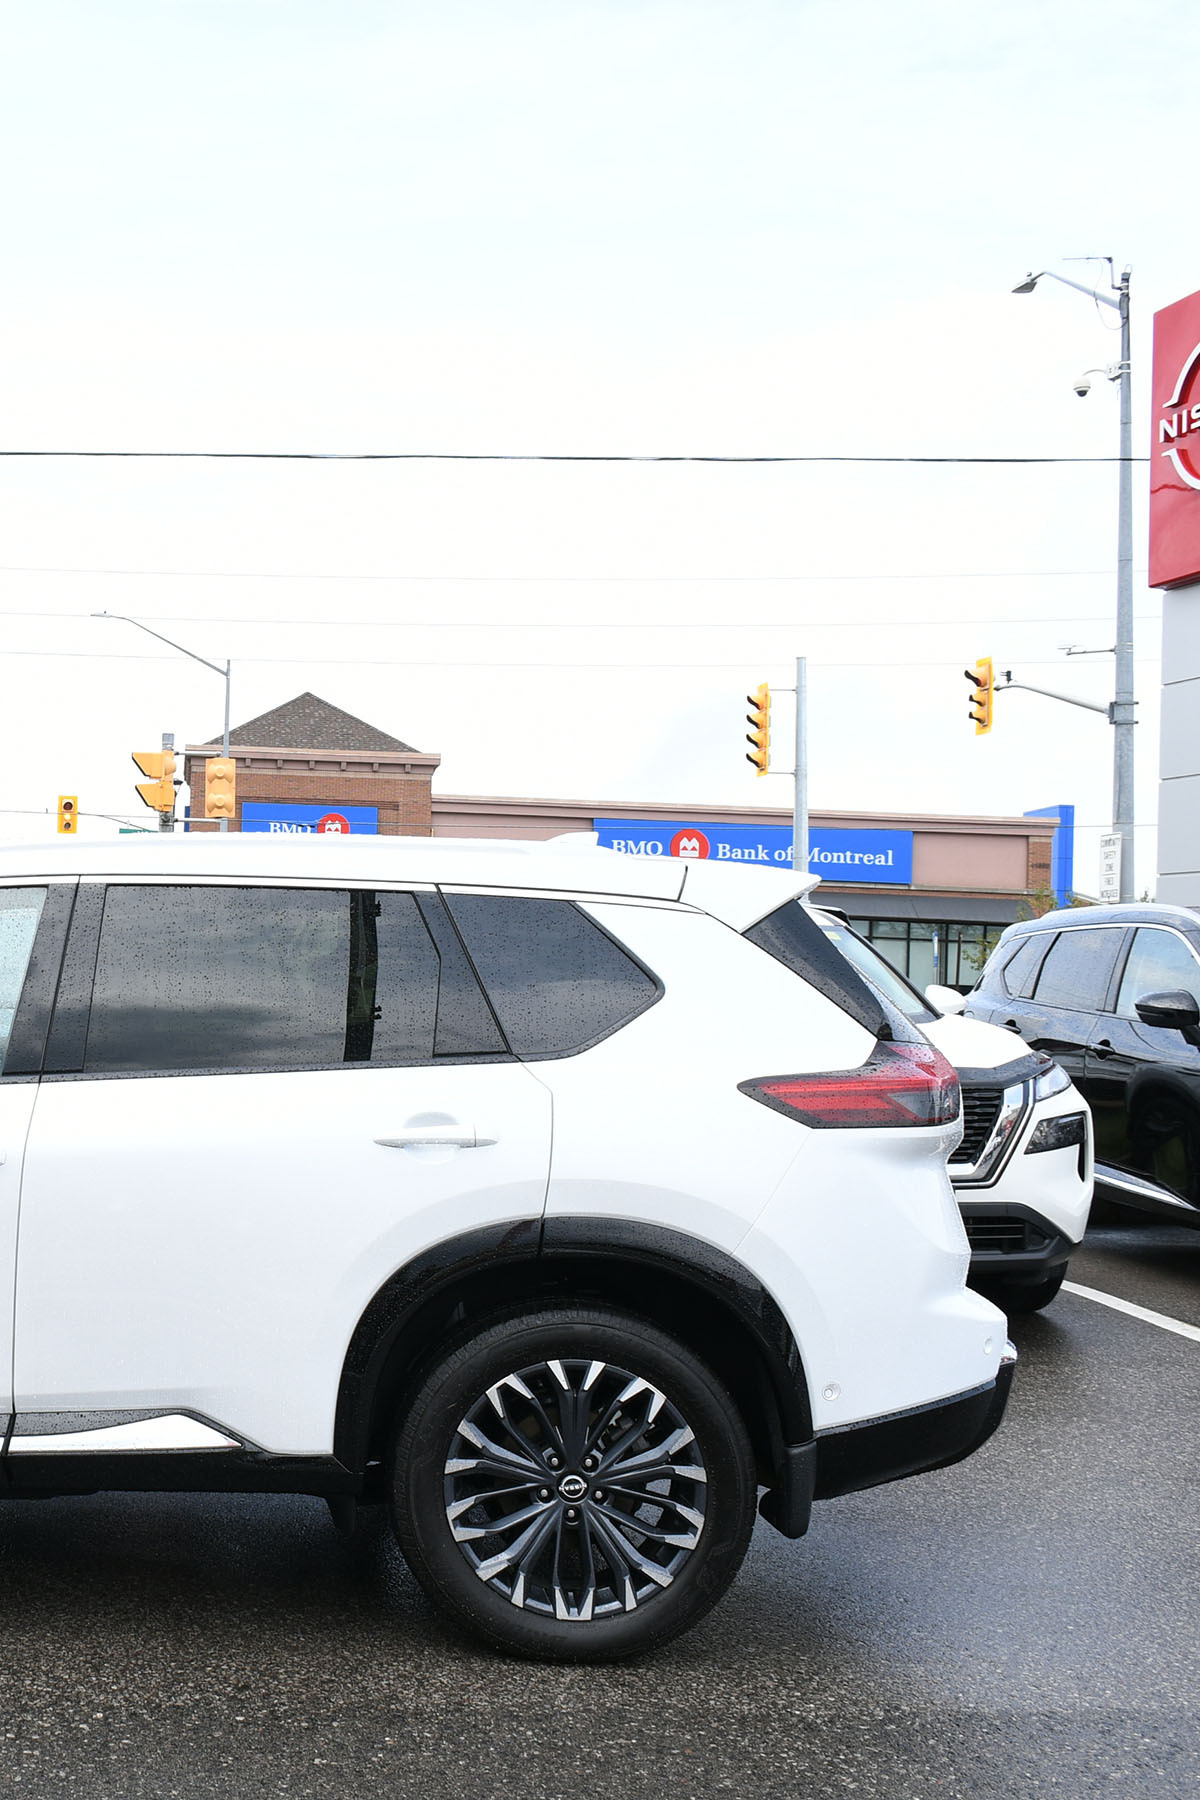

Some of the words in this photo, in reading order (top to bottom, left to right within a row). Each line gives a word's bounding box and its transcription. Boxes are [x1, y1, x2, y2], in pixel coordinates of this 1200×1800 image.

[268, 821, 312, 833] BMO
[611, 839, 663, 856] BMO
[716, 843, 770, 861] Bank
[773, 845, 794, 862] of
